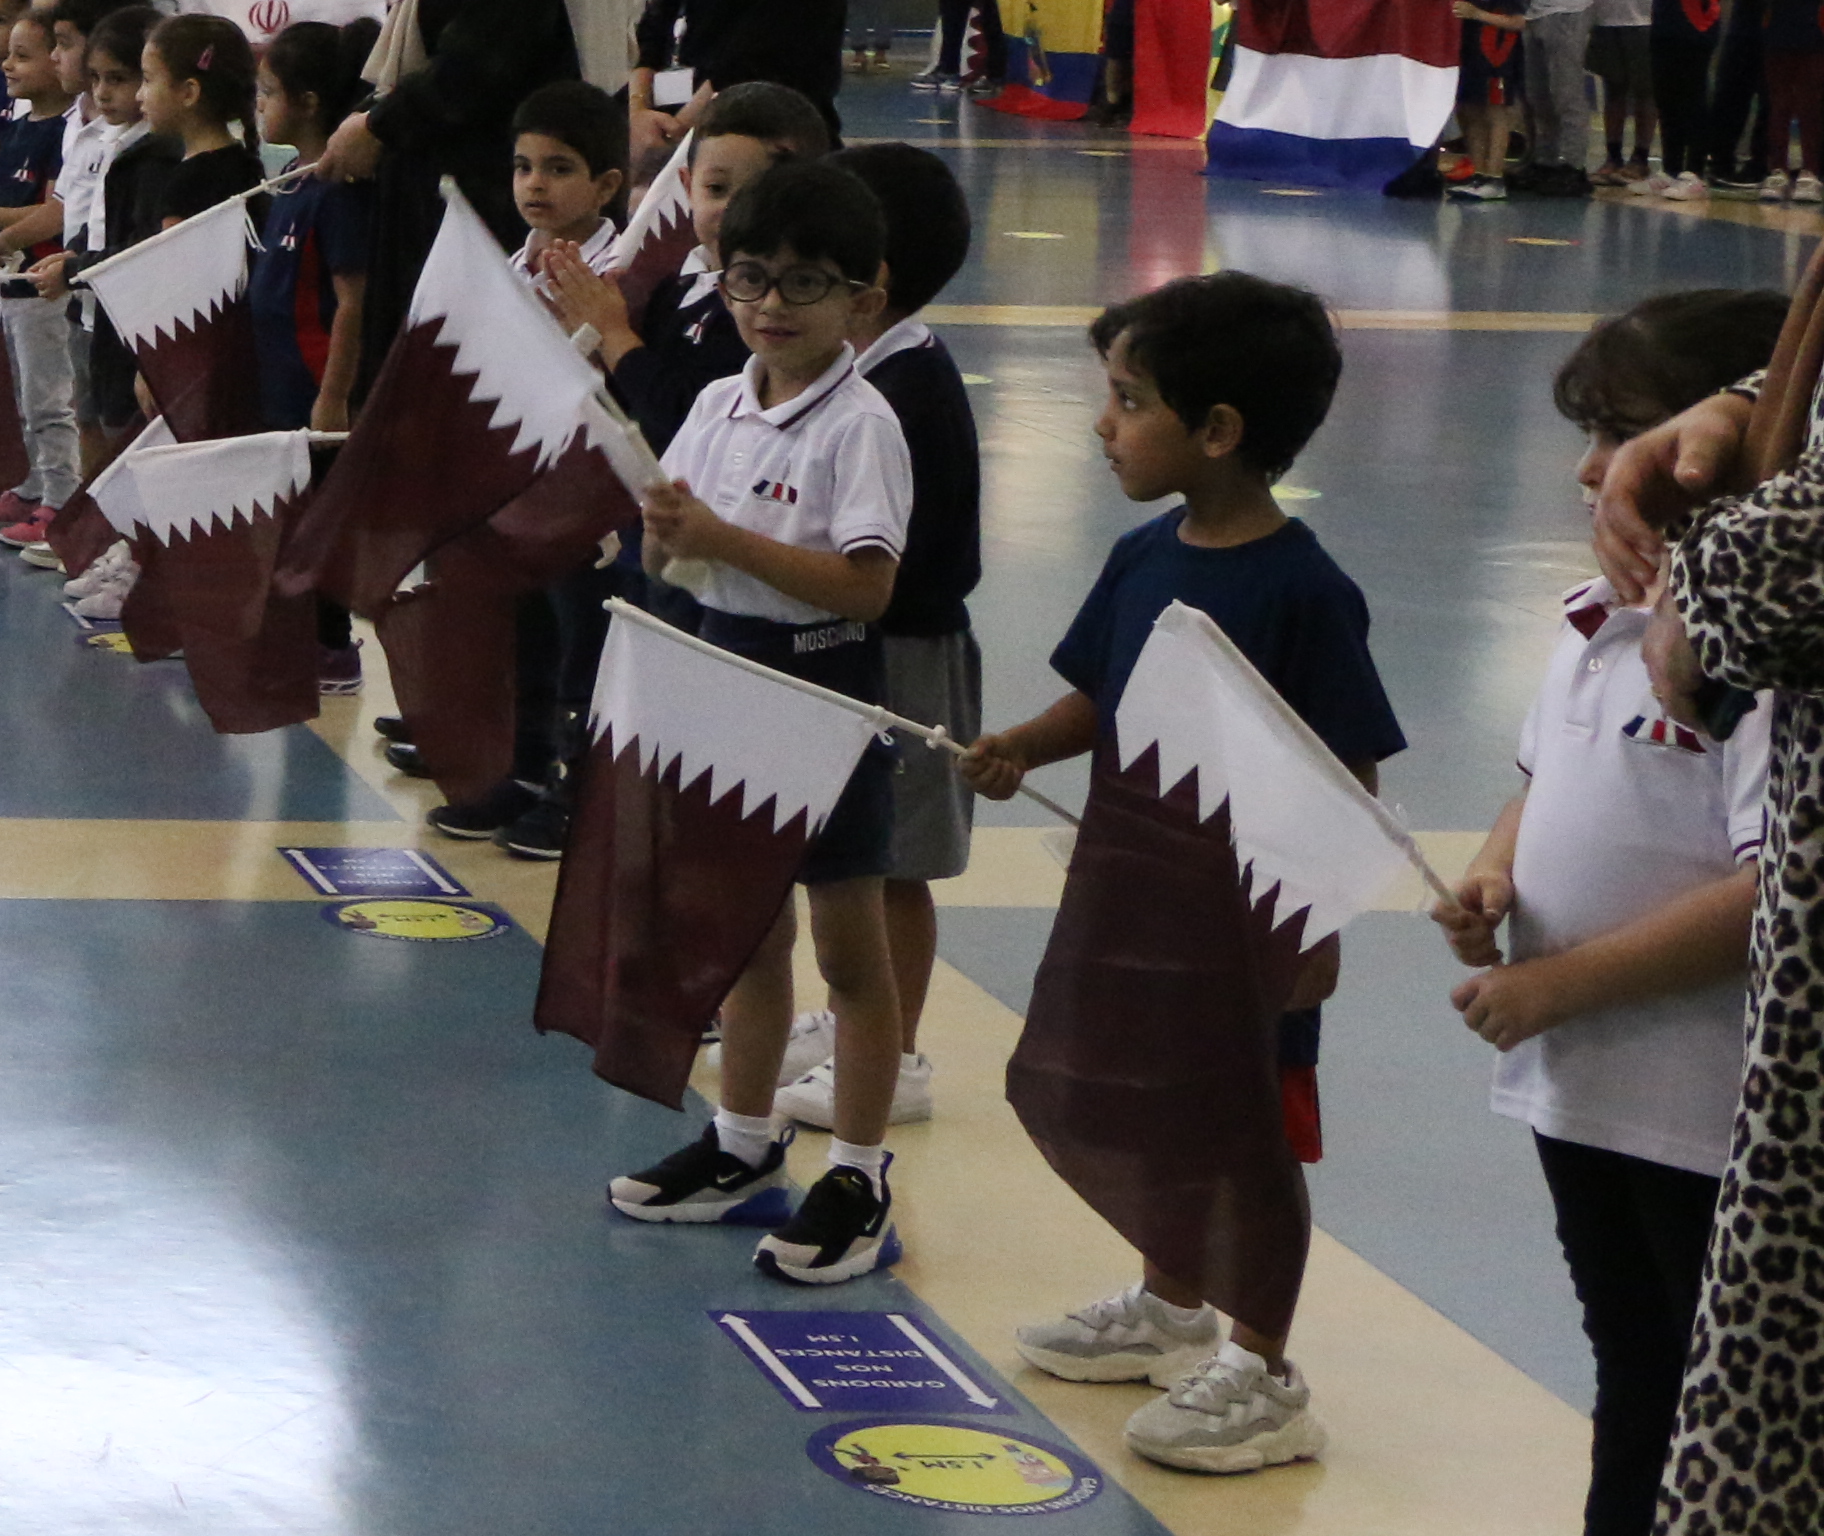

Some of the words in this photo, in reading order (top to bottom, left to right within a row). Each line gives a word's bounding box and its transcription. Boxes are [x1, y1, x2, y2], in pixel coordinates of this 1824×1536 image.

[806, 1333, 860, 1343] 1.5M
[775, 1348, 924, 1358] DISTANCES
[834, 1364, 894, 1373] NOS
[811, 1379, 946, 1389] GARDONS
[997, 1503, 1046, 1514] NOS
